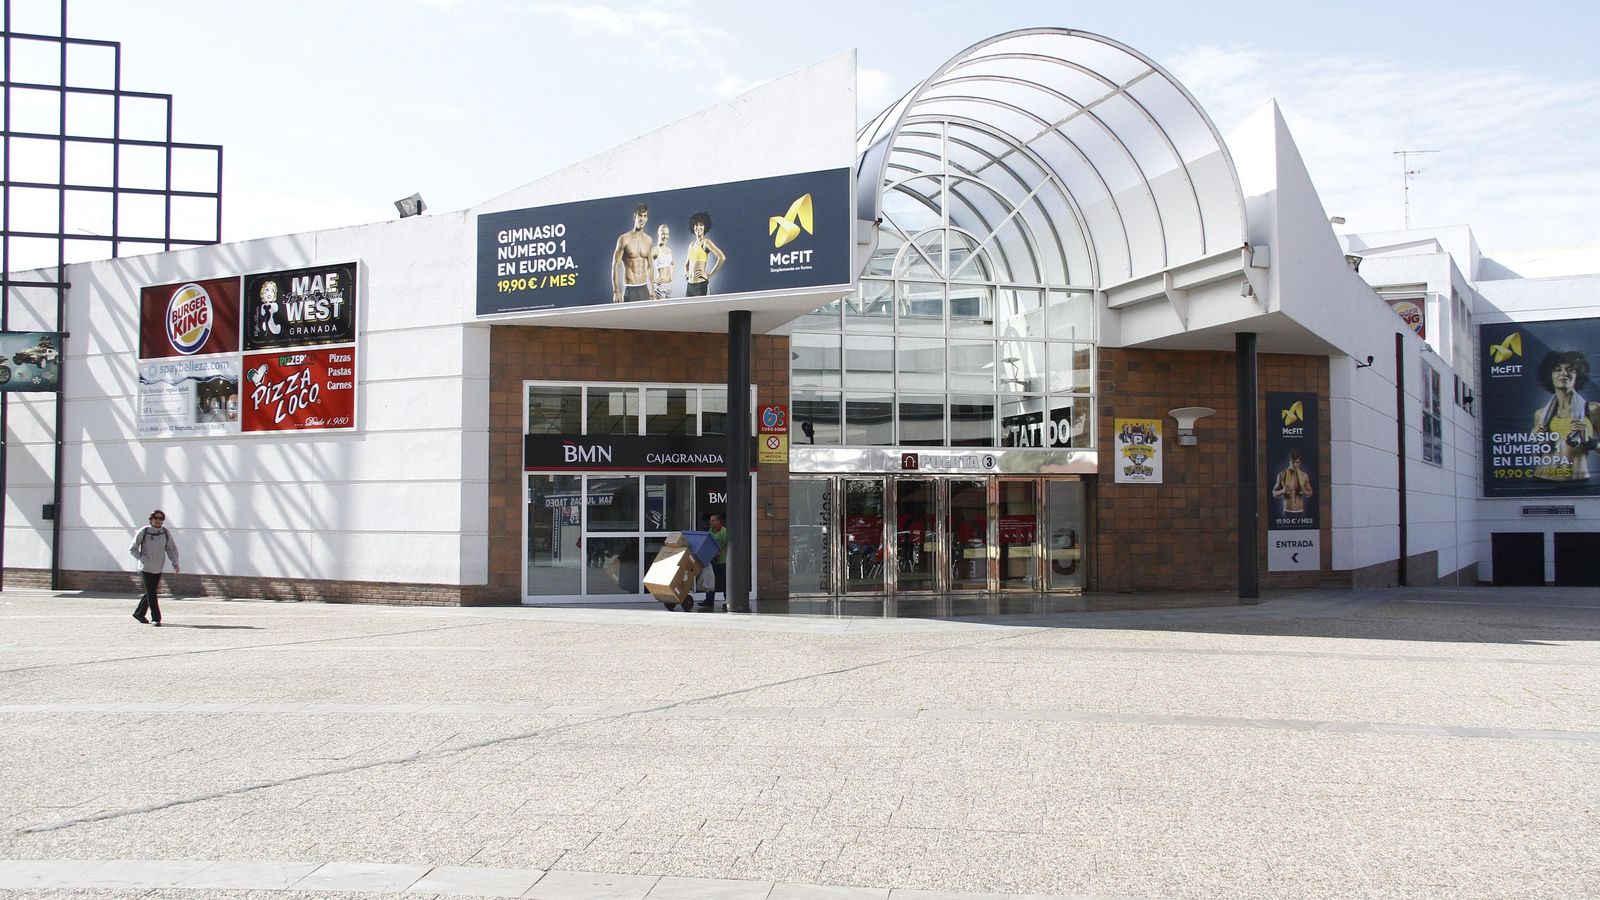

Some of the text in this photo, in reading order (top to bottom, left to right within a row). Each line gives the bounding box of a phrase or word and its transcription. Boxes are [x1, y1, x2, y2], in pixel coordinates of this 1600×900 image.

[498, 224, 566, 244] GIMNASIO
[498, 240, 566, 260] NÚMERO 1
[770, 250, 813, 266] McFIT
[498, 256, 578, 276] EN EUROPA.
[291, 273, 339, 296] MAE
[172, 296, 206, 323] BURGER
[286, 298, 344, 322] WEST
[174, 307, 208, 340] KING
[290, 324, 337, 336] GRANADA
[329, 354, 352, 363] Pizzas
[160, 361, 228, 376] spaybelleza.com
[328, 368, 352, 376] Pastas
[1491, 365, 1522, 374] McFIT
[327, 381, 352, 390] Carnes
[274, 383, 319, 424] LOCO
[1492, 432, 1560, 442] GIMNASIO
[563, 445, 612, 462] BMN
[1493, 442, 1560, 454] NÚMERO 1
[646, 453, 724, 464] CAJAGRANADA
[921, 455, 979, 469] PUERTA
[1493, 455, 1573, 466] EN EUROPA.
[708, 492, 727, 504] BM
[1276, 540, 1314, 548] ENTRADA
